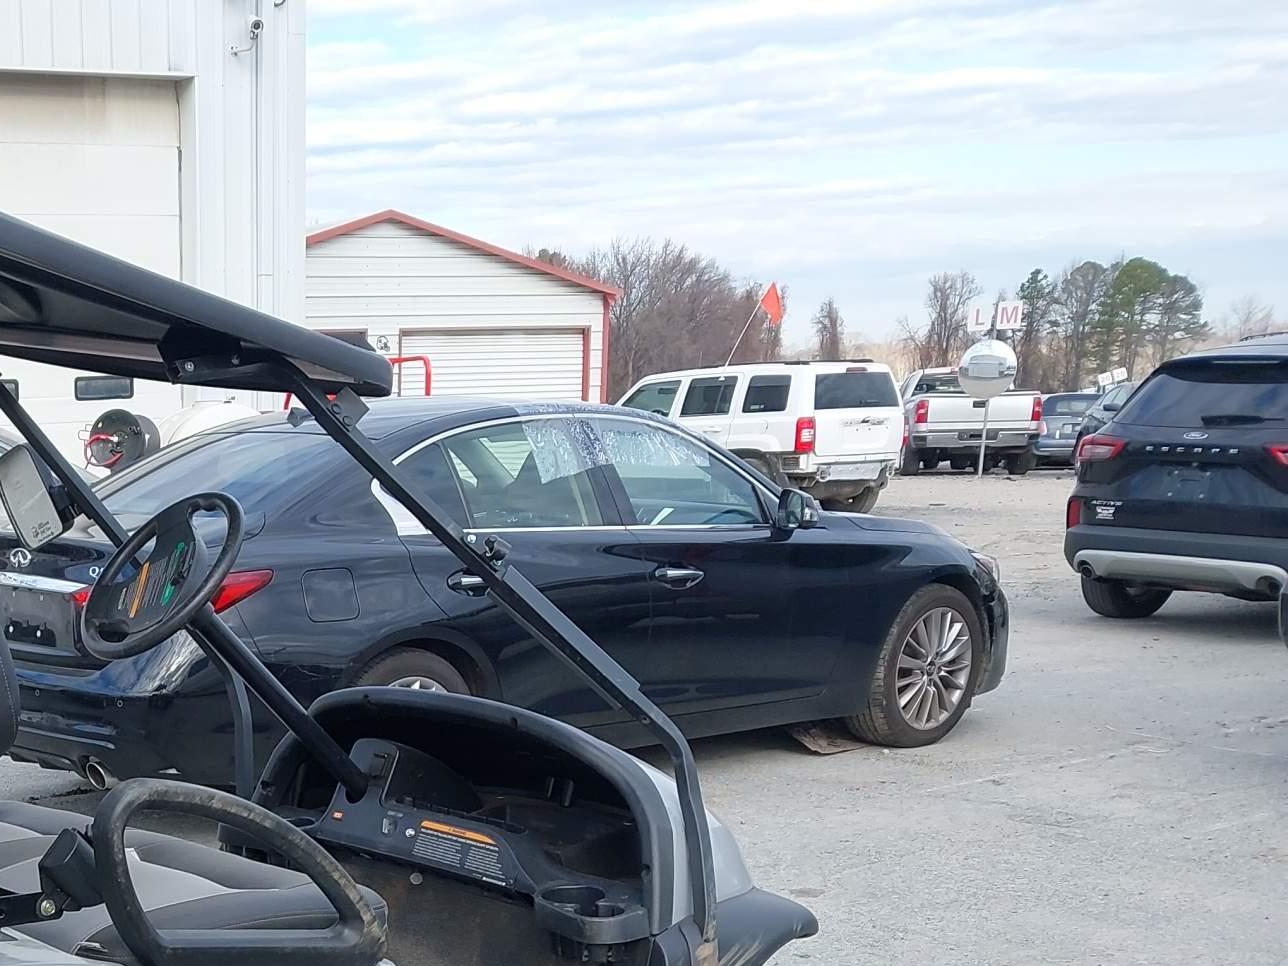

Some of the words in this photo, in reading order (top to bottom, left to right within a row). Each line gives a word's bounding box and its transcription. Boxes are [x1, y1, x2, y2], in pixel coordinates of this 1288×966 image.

[975, 308, 985, 326] L
[1000, 305, 1020, 325] M
[1145, 445, 1240, 455] ESCAPE
